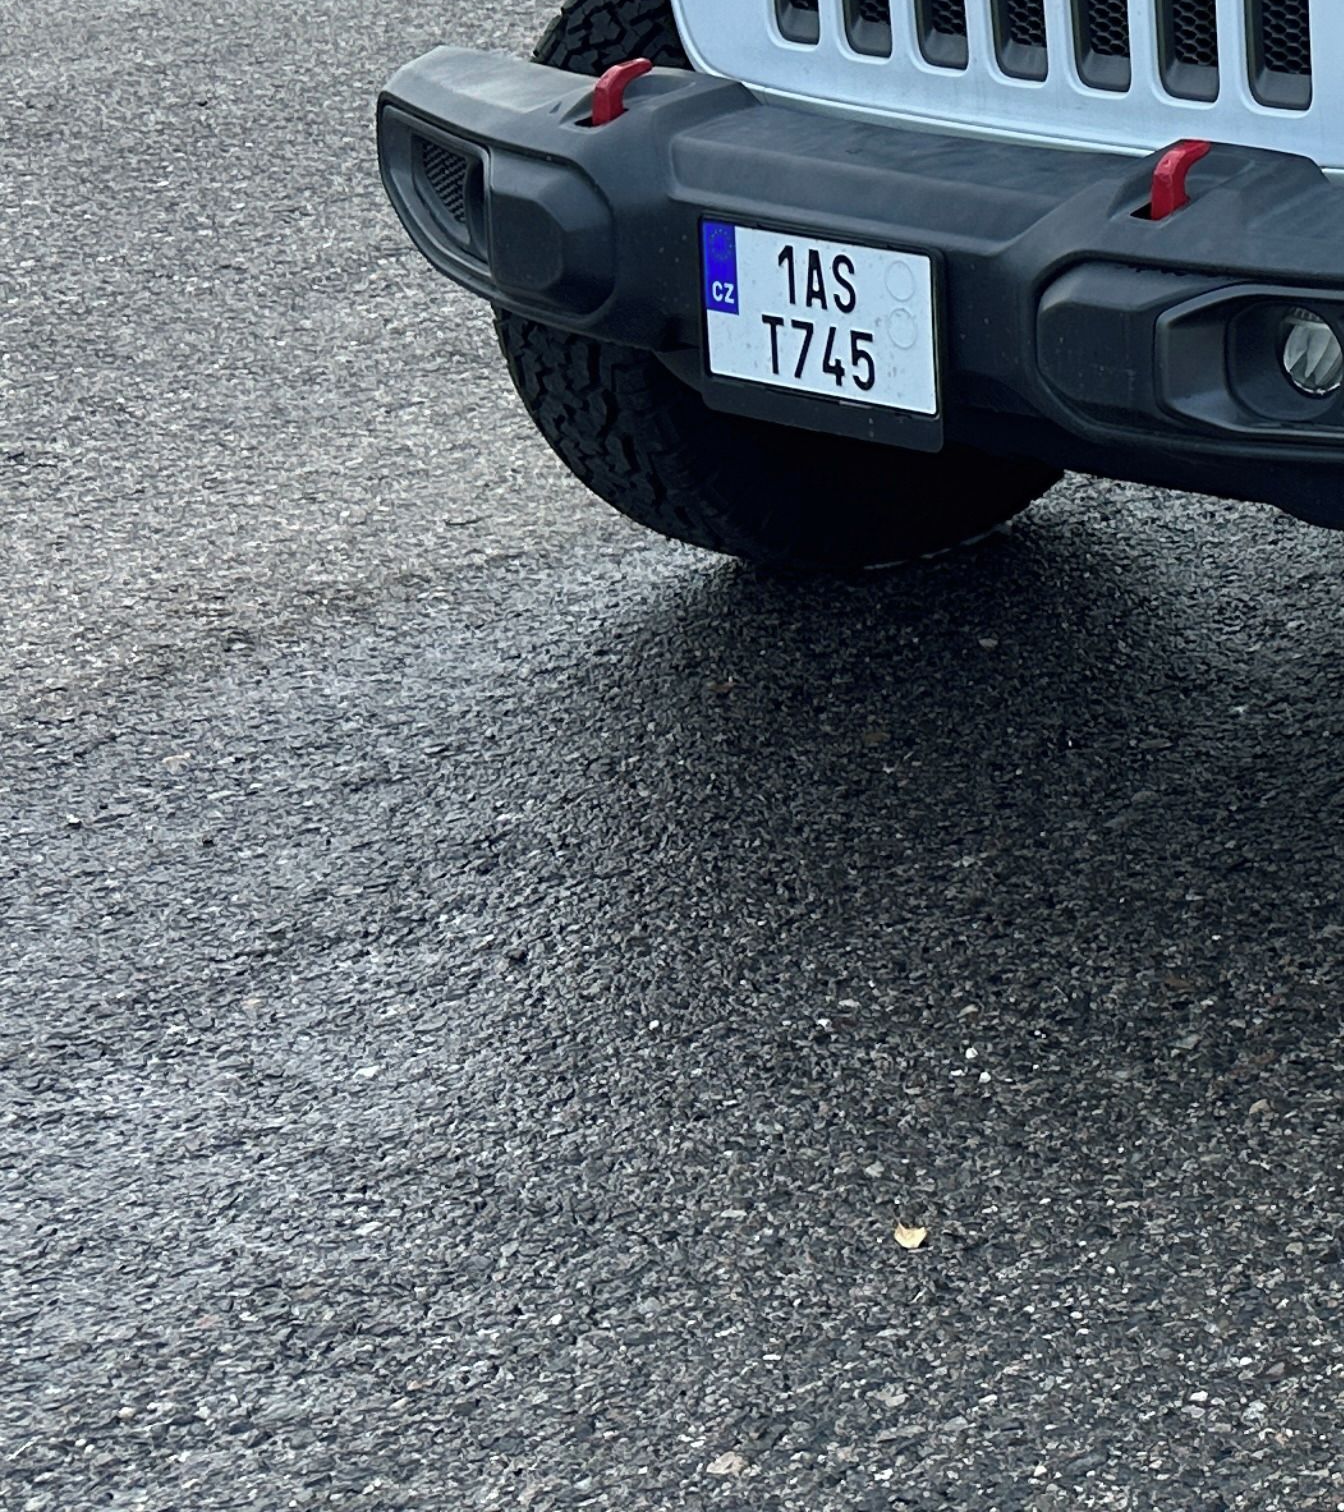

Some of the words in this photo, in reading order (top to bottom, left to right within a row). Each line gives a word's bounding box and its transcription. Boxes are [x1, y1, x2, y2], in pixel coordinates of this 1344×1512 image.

[711, 280, 735, 305] CZ
[778, 245, 856, 314] 1AS
[762, 314, 875, 392] T745
